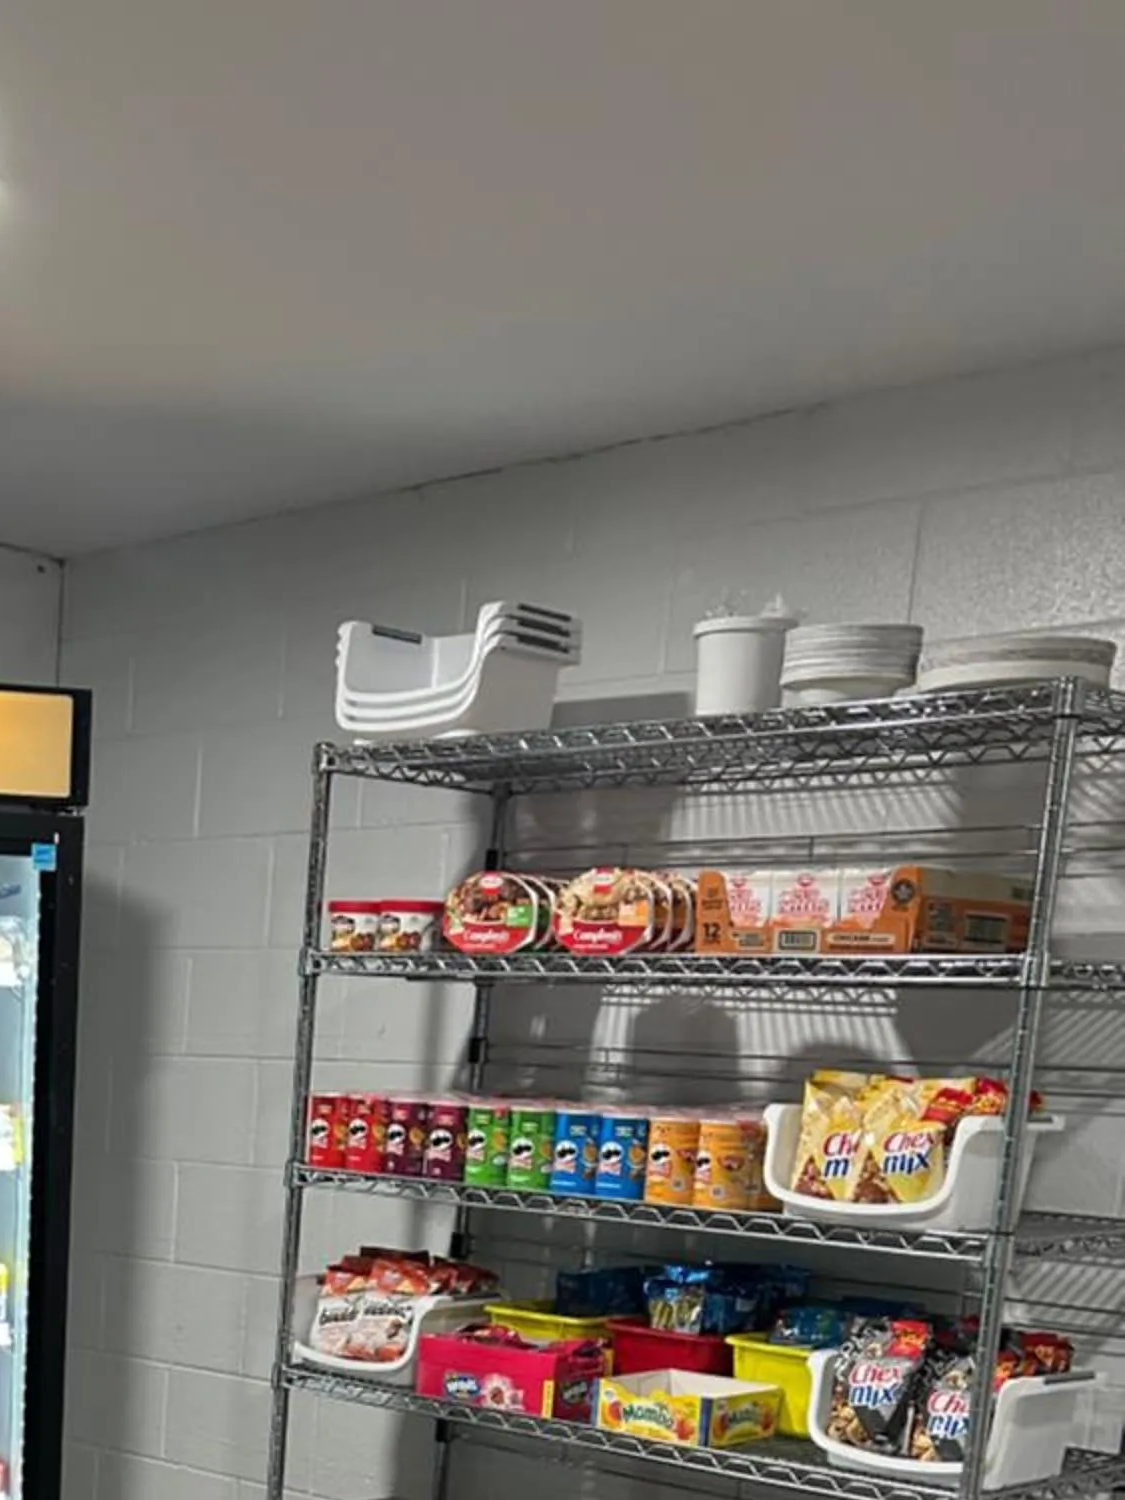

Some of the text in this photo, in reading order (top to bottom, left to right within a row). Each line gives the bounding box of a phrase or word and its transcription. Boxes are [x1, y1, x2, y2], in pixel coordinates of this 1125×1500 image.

[883, 1131, 934, 1152] Chex
[883, 1151, 932, 1174] mix
[849, 1363, 901, 1386] Chex
[849, 1384, 899, 1406] mix
